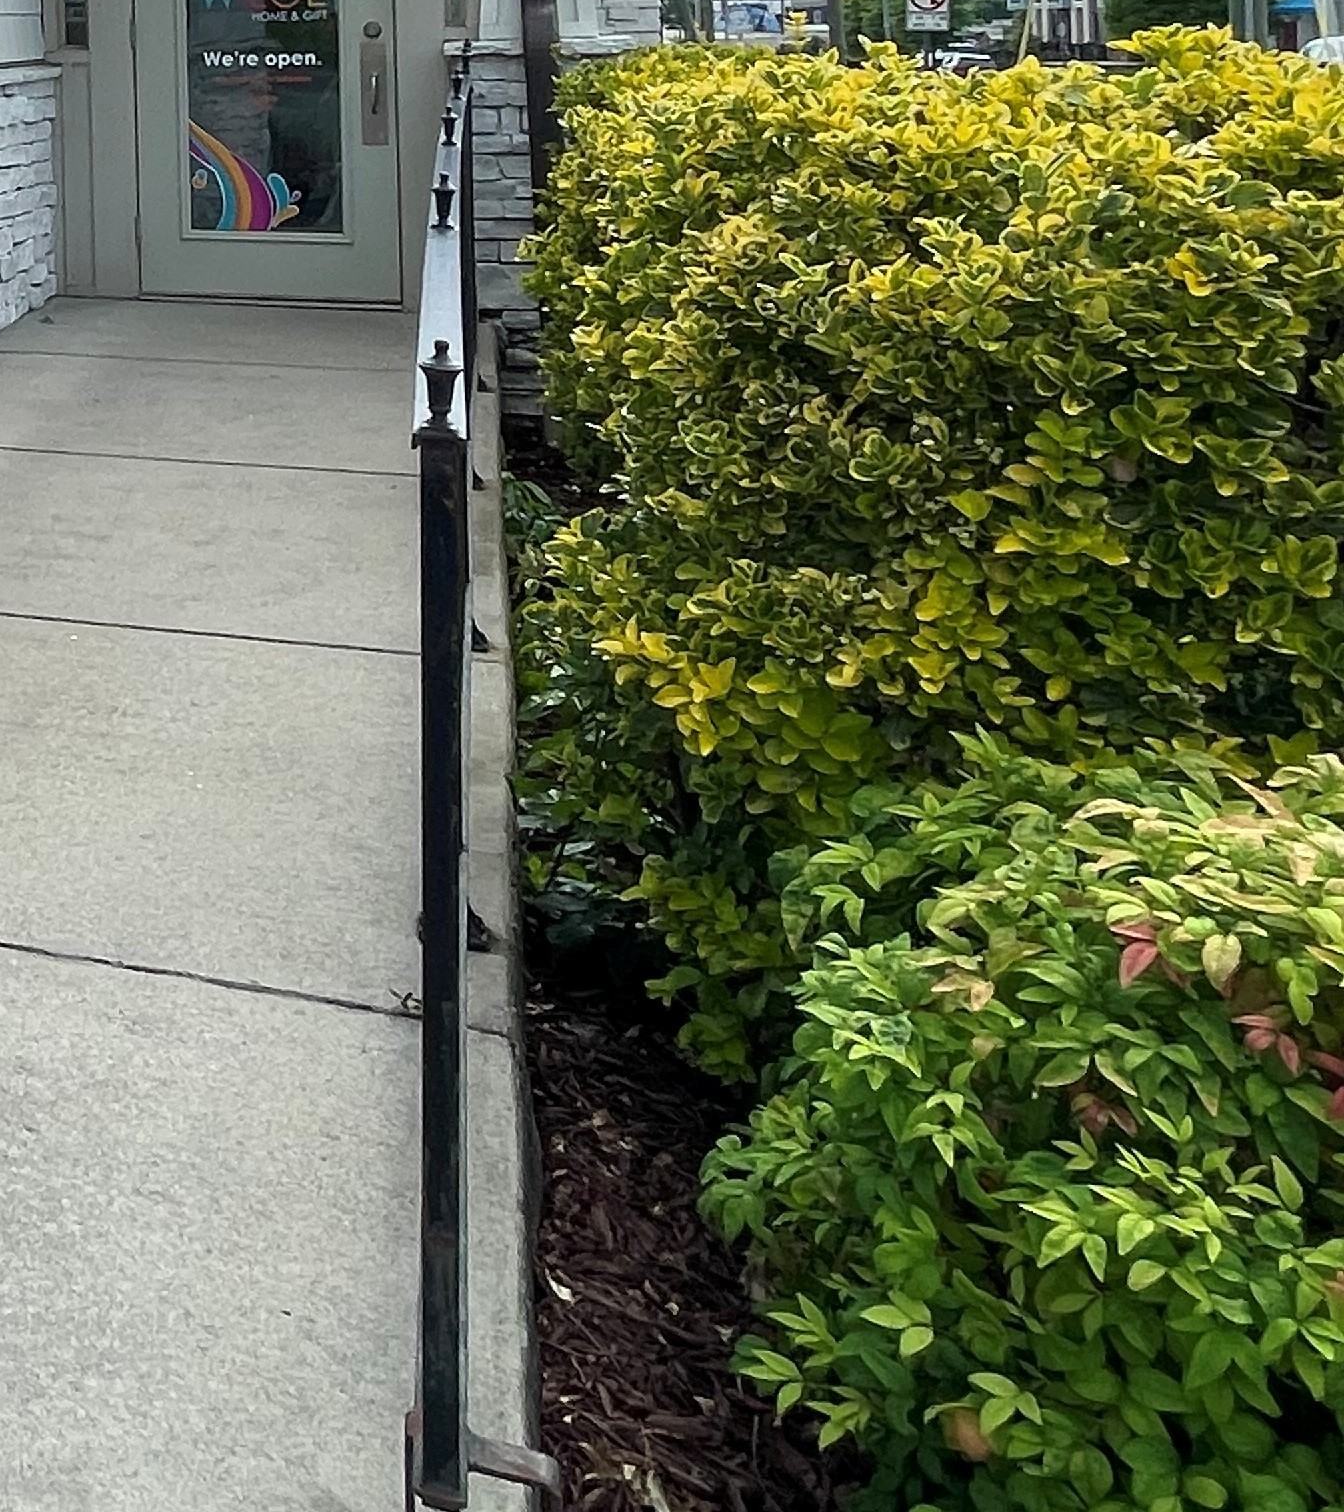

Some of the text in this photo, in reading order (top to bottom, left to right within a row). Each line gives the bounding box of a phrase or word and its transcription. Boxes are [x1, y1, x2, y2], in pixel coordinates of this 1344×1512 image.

[251, 9, 328, 23] HOME & GIFT
[203, 50, 324, 70] We're open.
